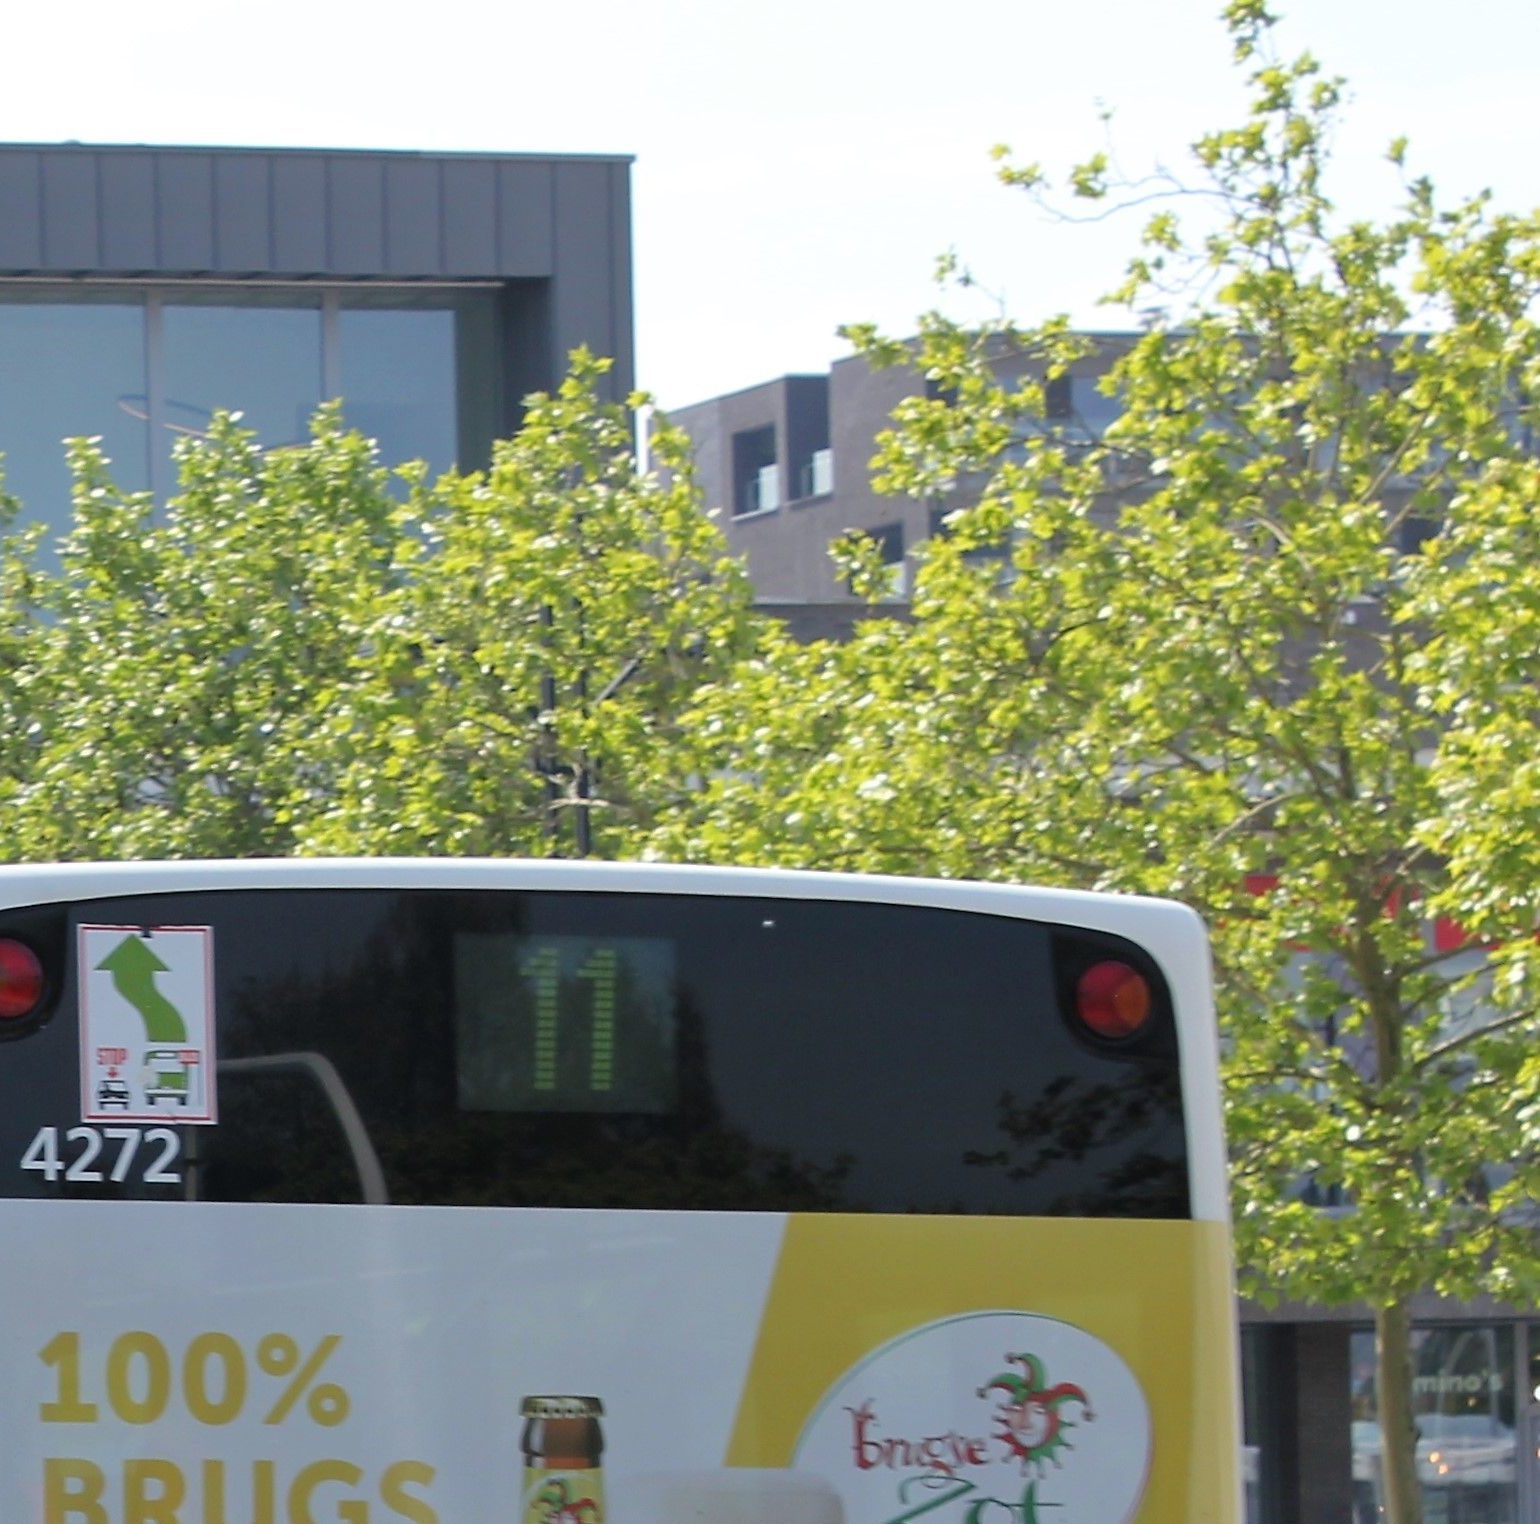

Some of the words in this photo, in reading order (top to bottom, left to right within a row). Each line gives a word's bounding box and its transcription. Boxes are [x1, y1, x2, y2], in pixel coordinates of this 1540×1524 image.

[520, 947, 617, 1091] 11
[21, 1125, 182, 1183] 4272
[36, 1331, 351, 1428] 100%
